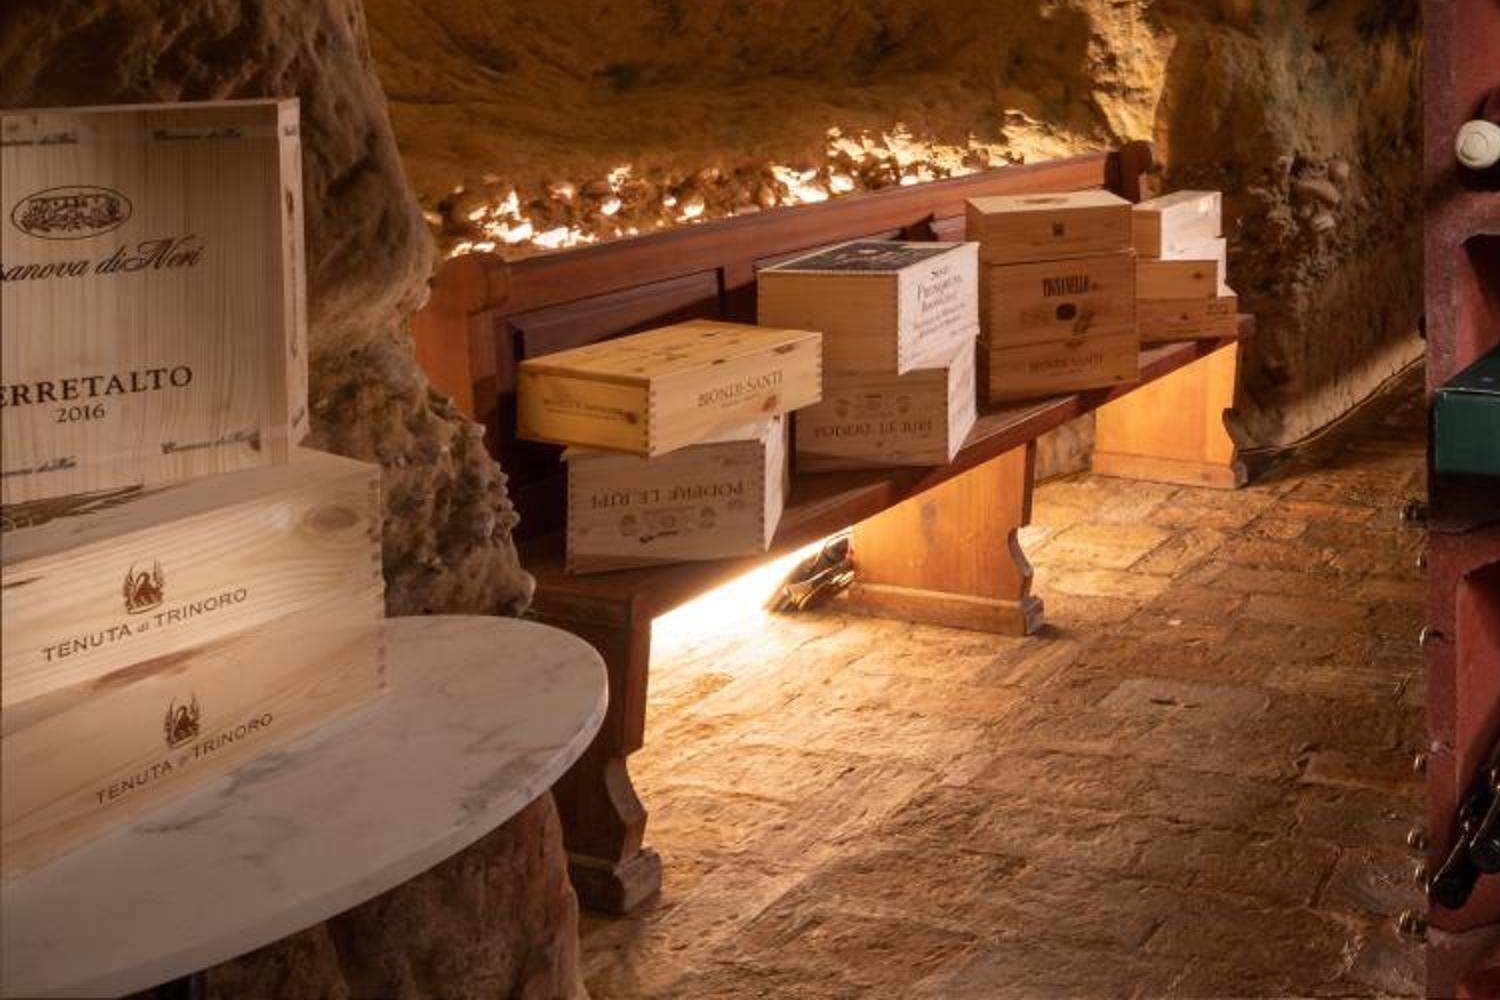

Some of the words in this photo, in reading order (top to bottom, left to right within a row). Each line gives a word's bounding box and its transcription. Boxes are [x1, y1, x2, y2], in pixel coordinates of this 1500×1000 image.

[56, 404, 106, 424] 2016
[42, 623, 133, 662] TENUTA
[154, 588, 248, 628] TRINORO
[96, 759, 173, 804] TENUTA
[192, 713, 274, 758] TRINORO
